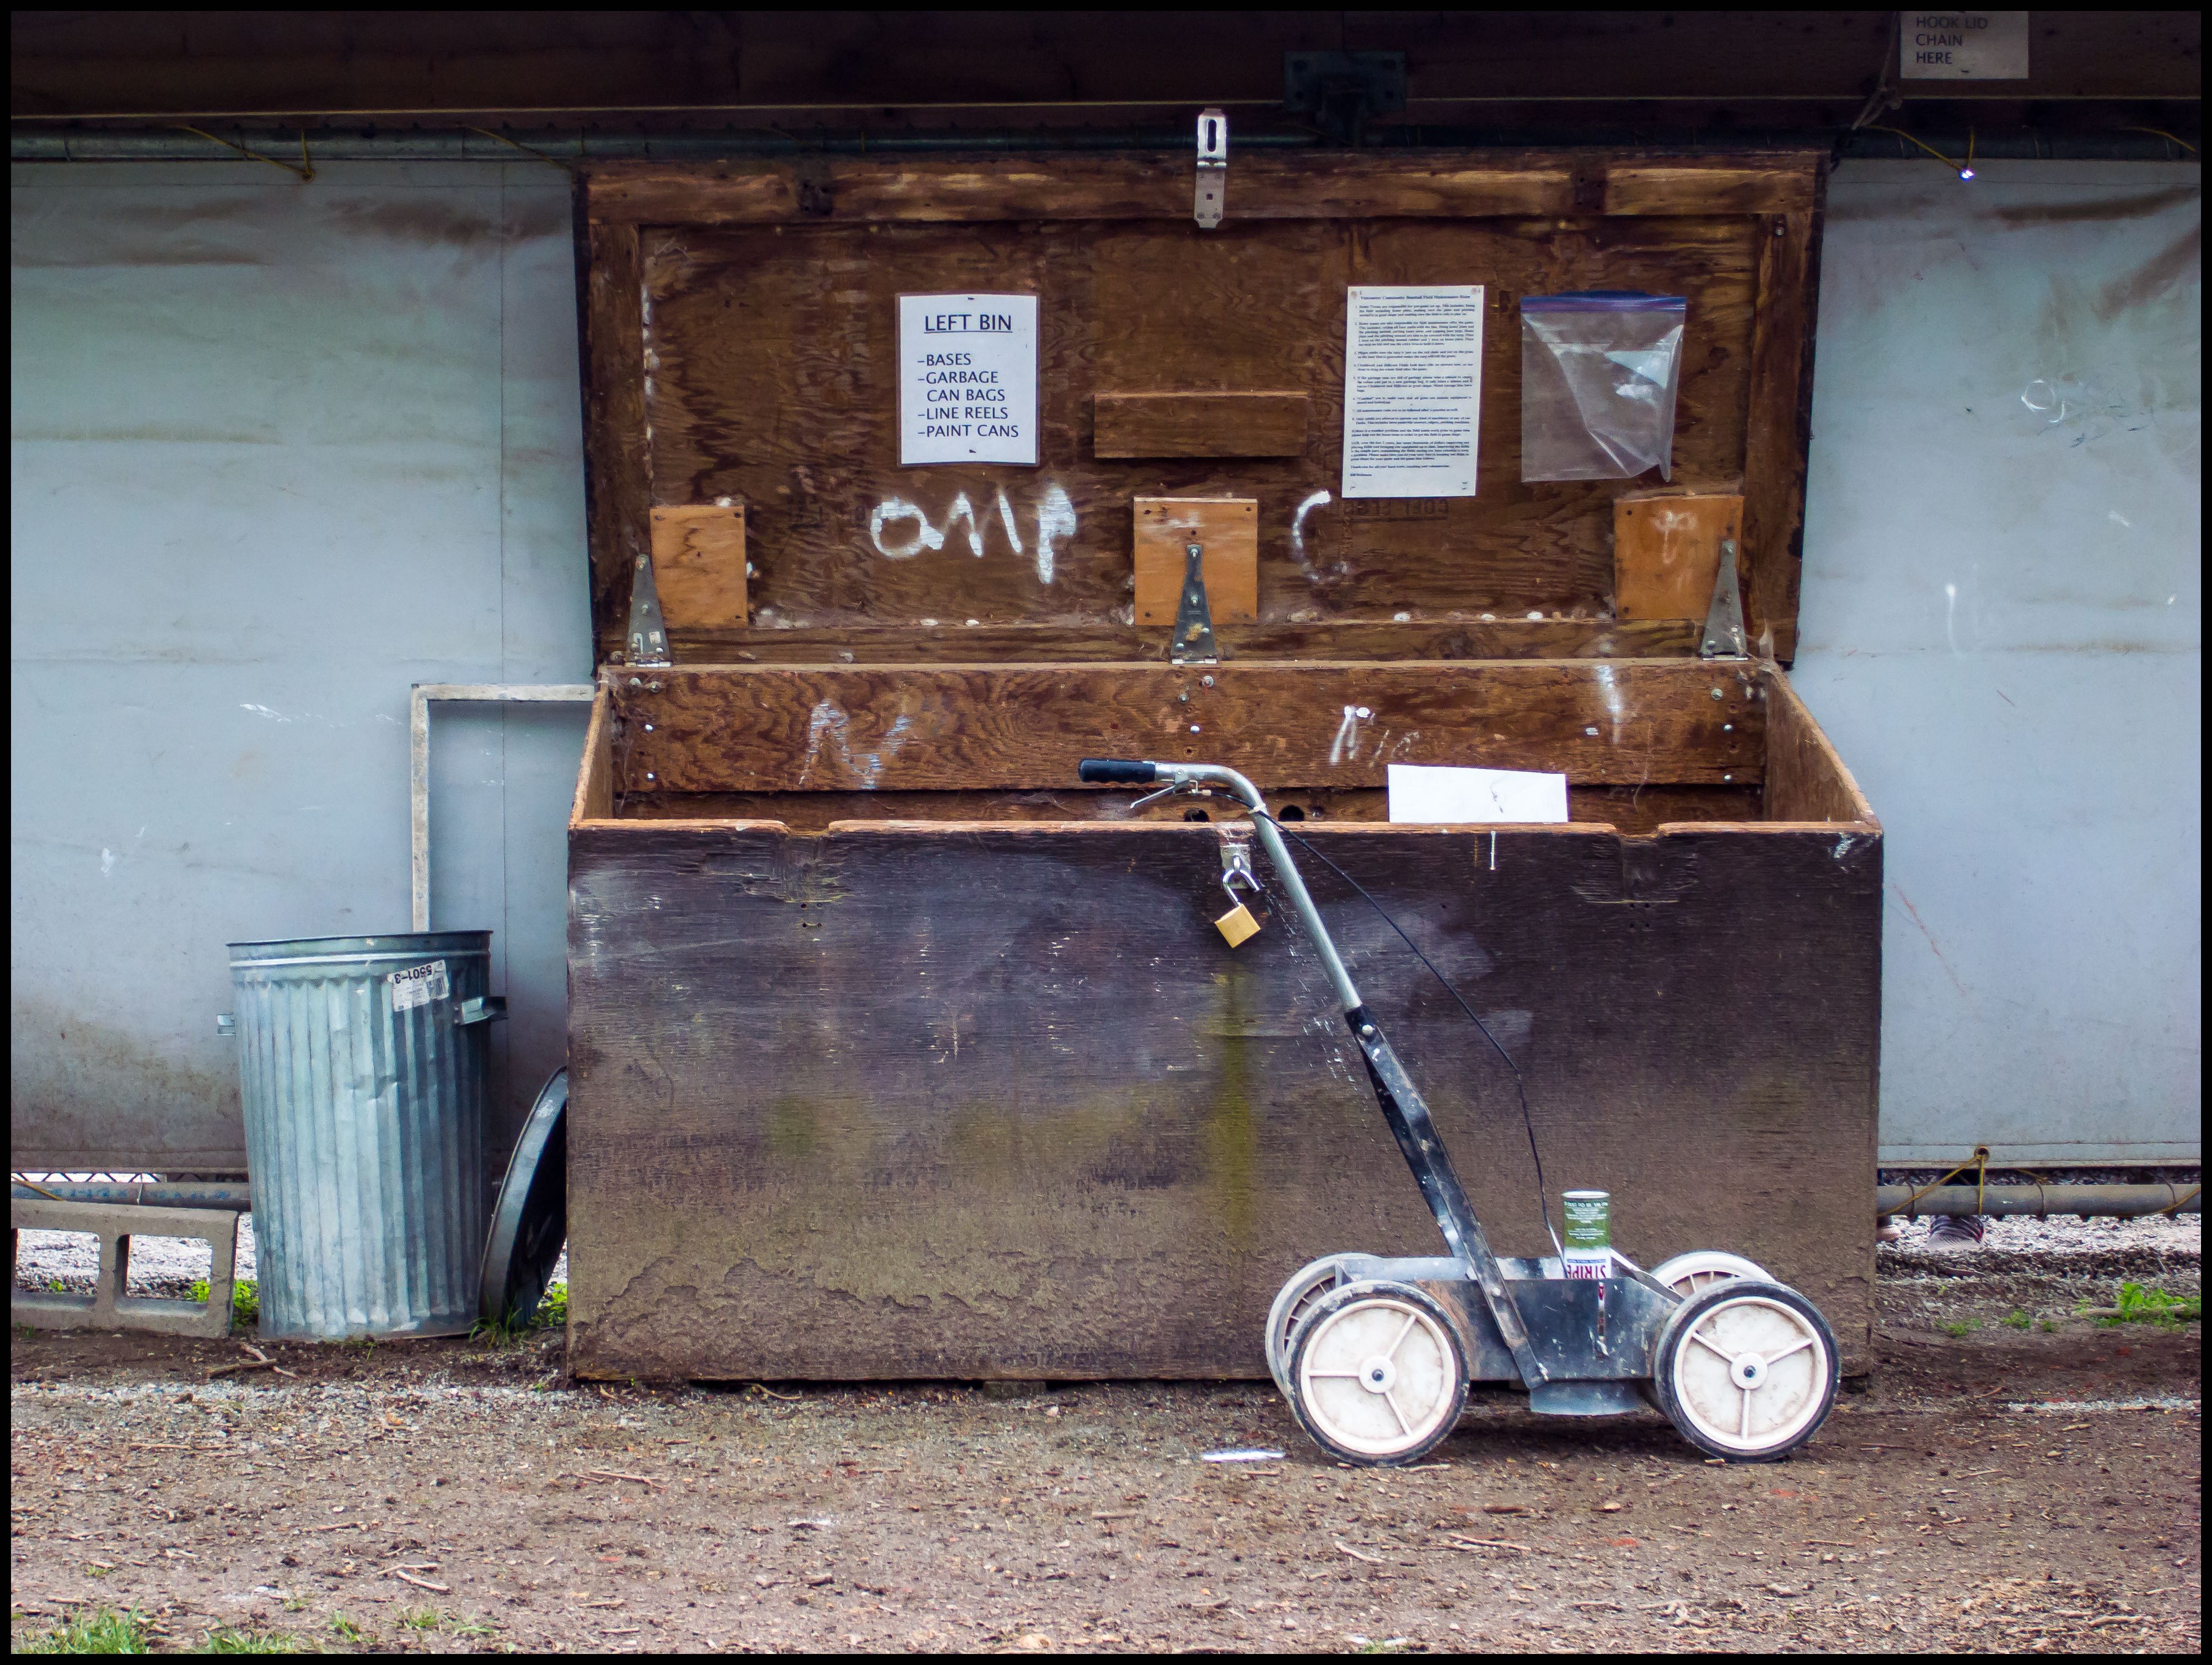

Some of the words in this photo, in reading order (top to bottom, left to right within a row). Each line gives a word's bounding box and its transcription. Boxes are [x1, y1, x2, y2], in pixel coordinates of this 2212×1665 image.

[1915, 16, 1958, 29] HOOK
[1964, 17, 1988, 29] LID
[1915, 33, 1963, 47] CHAIN
[1915, 51, 1953, 65] HERE
[925, 314, 972, 332] LEFT
[979, 314, 1012, 331] BIN
[917, 353, 971, 366] -BASES
[917, 371, 999, 384] -GARBAGE
[927, 389, 960, 402] CAN
[965, 389, 1006, 401] BAGS
[917, 407, 959, 420] -LINE
[964, 406, 1008, 420] REELS
[917, 424, 972, 438] -PAINT
[977, 424, 1019, 438] CANS
[394, 965, 433, 984] 5501-3
